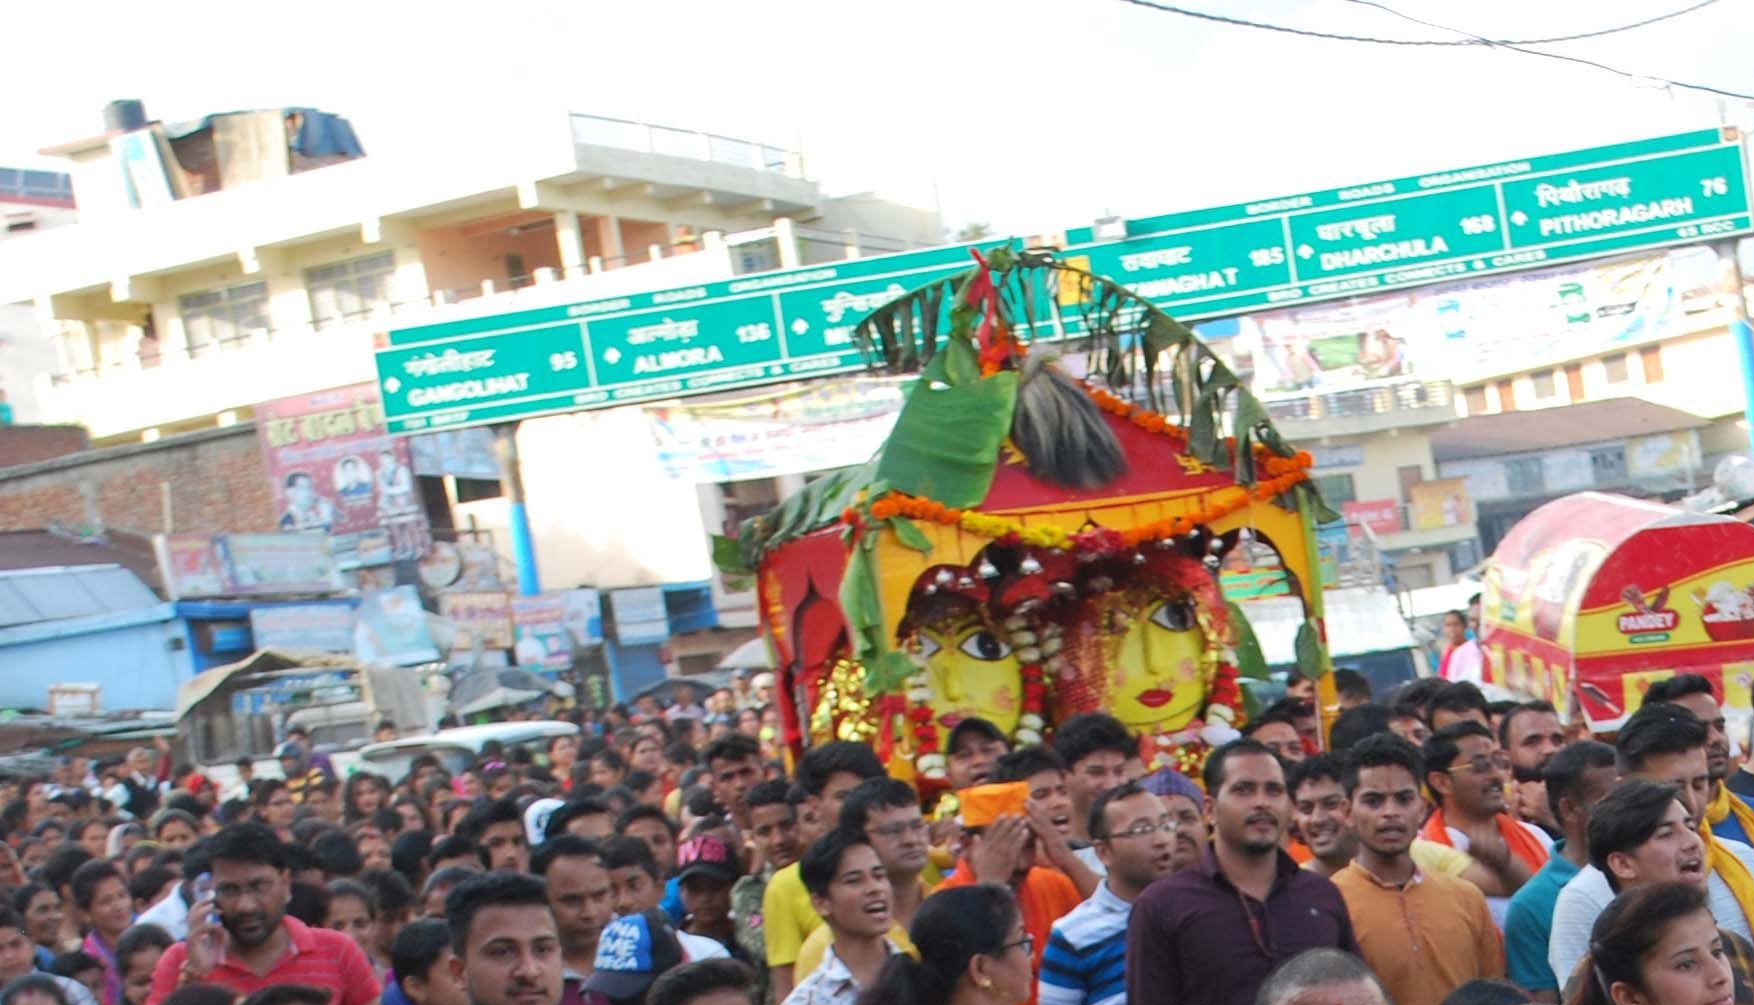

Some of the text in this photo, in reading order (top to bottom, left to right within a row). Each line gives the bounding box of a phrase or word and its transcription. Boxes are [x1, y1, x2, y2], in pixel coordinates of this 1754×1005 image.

[1245, 196, 1313, 215] BORDER
[1338, 182, 1396, 200] ROADS
[1698, 176, 1729, 198] 76
[1539, 197, 1695, 237] PITHORAGARH
[1319, 235, 1450, 271] DHARCHULA
[1491, 248, 1548, 267] CARES
[549, 350, 579, 372] 95
[632, 344, 725, 375] ALMORA
[406, 372, 531, 408] GANGOLIHAT
[1619, 611, 1676, 632] PANDEY
